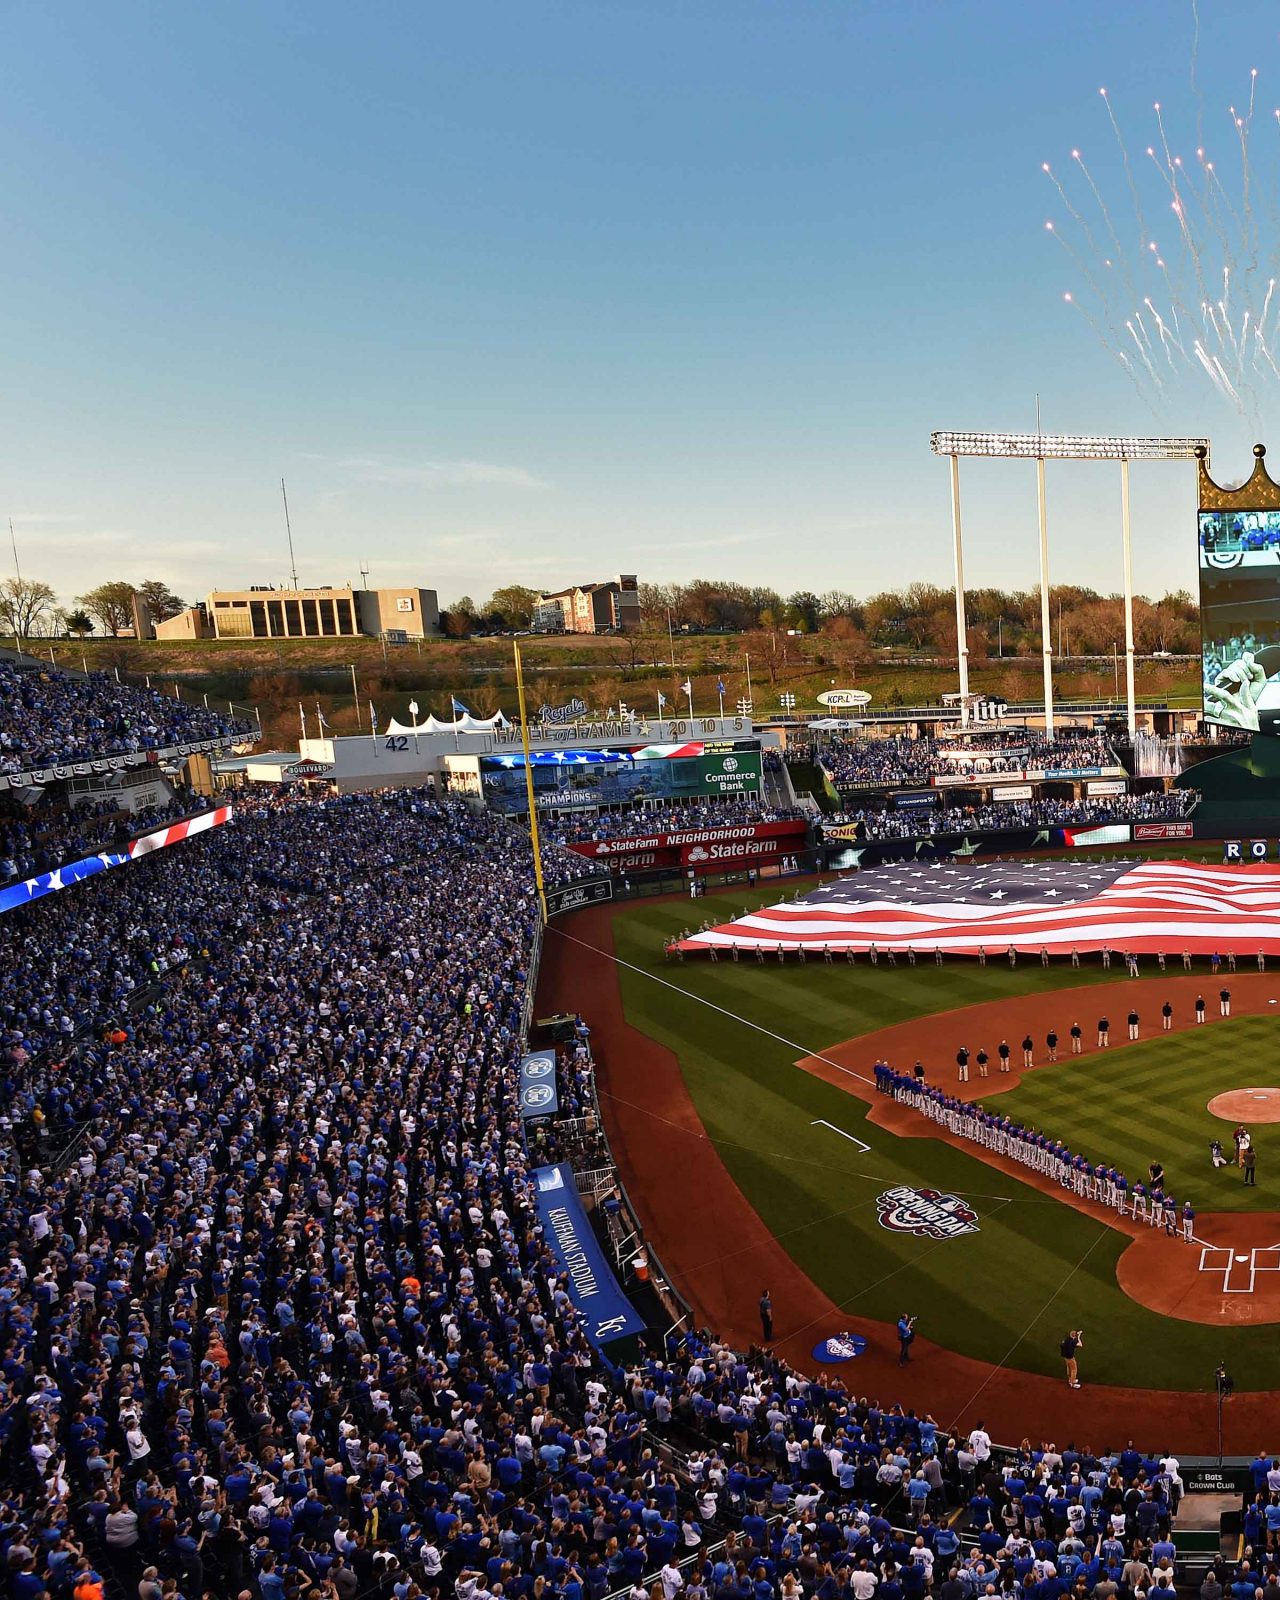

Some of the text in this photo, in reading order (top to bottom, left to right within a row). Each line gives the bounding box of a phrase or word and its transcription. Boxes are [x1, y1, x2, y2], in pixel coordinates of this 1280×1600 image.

[539, 698, 588, 725] Royals
[970, 700, 1008, 724] Lite
[493, 725, 553, 743] HALL
[575, 720, 632, 739] FAME
[668, 718, 743, 735] 20 10 5
[385, 736, 409, 751] 42
[288, 764, 328, 774] BOULEVARD
[705, 772, 756, 783] Commerce
[719, 781, 744, 791] Bank
[540, 792, 591, 806] CHAMPIONS
[666, 827, 755, 845] NEIGHBORHOOD
[825, 828, 857, 838] SONIC
[886, 1187, 976, 1236] OPENING DAY
[547, 1207, 600, 1299] KAUFFMAN STADIUM
[595, 1314, 627, 1338] KC
[1189, 1481, 1235, 1489] CROWN CLUB
[1204, 1473, 1223, 1481] Bats
